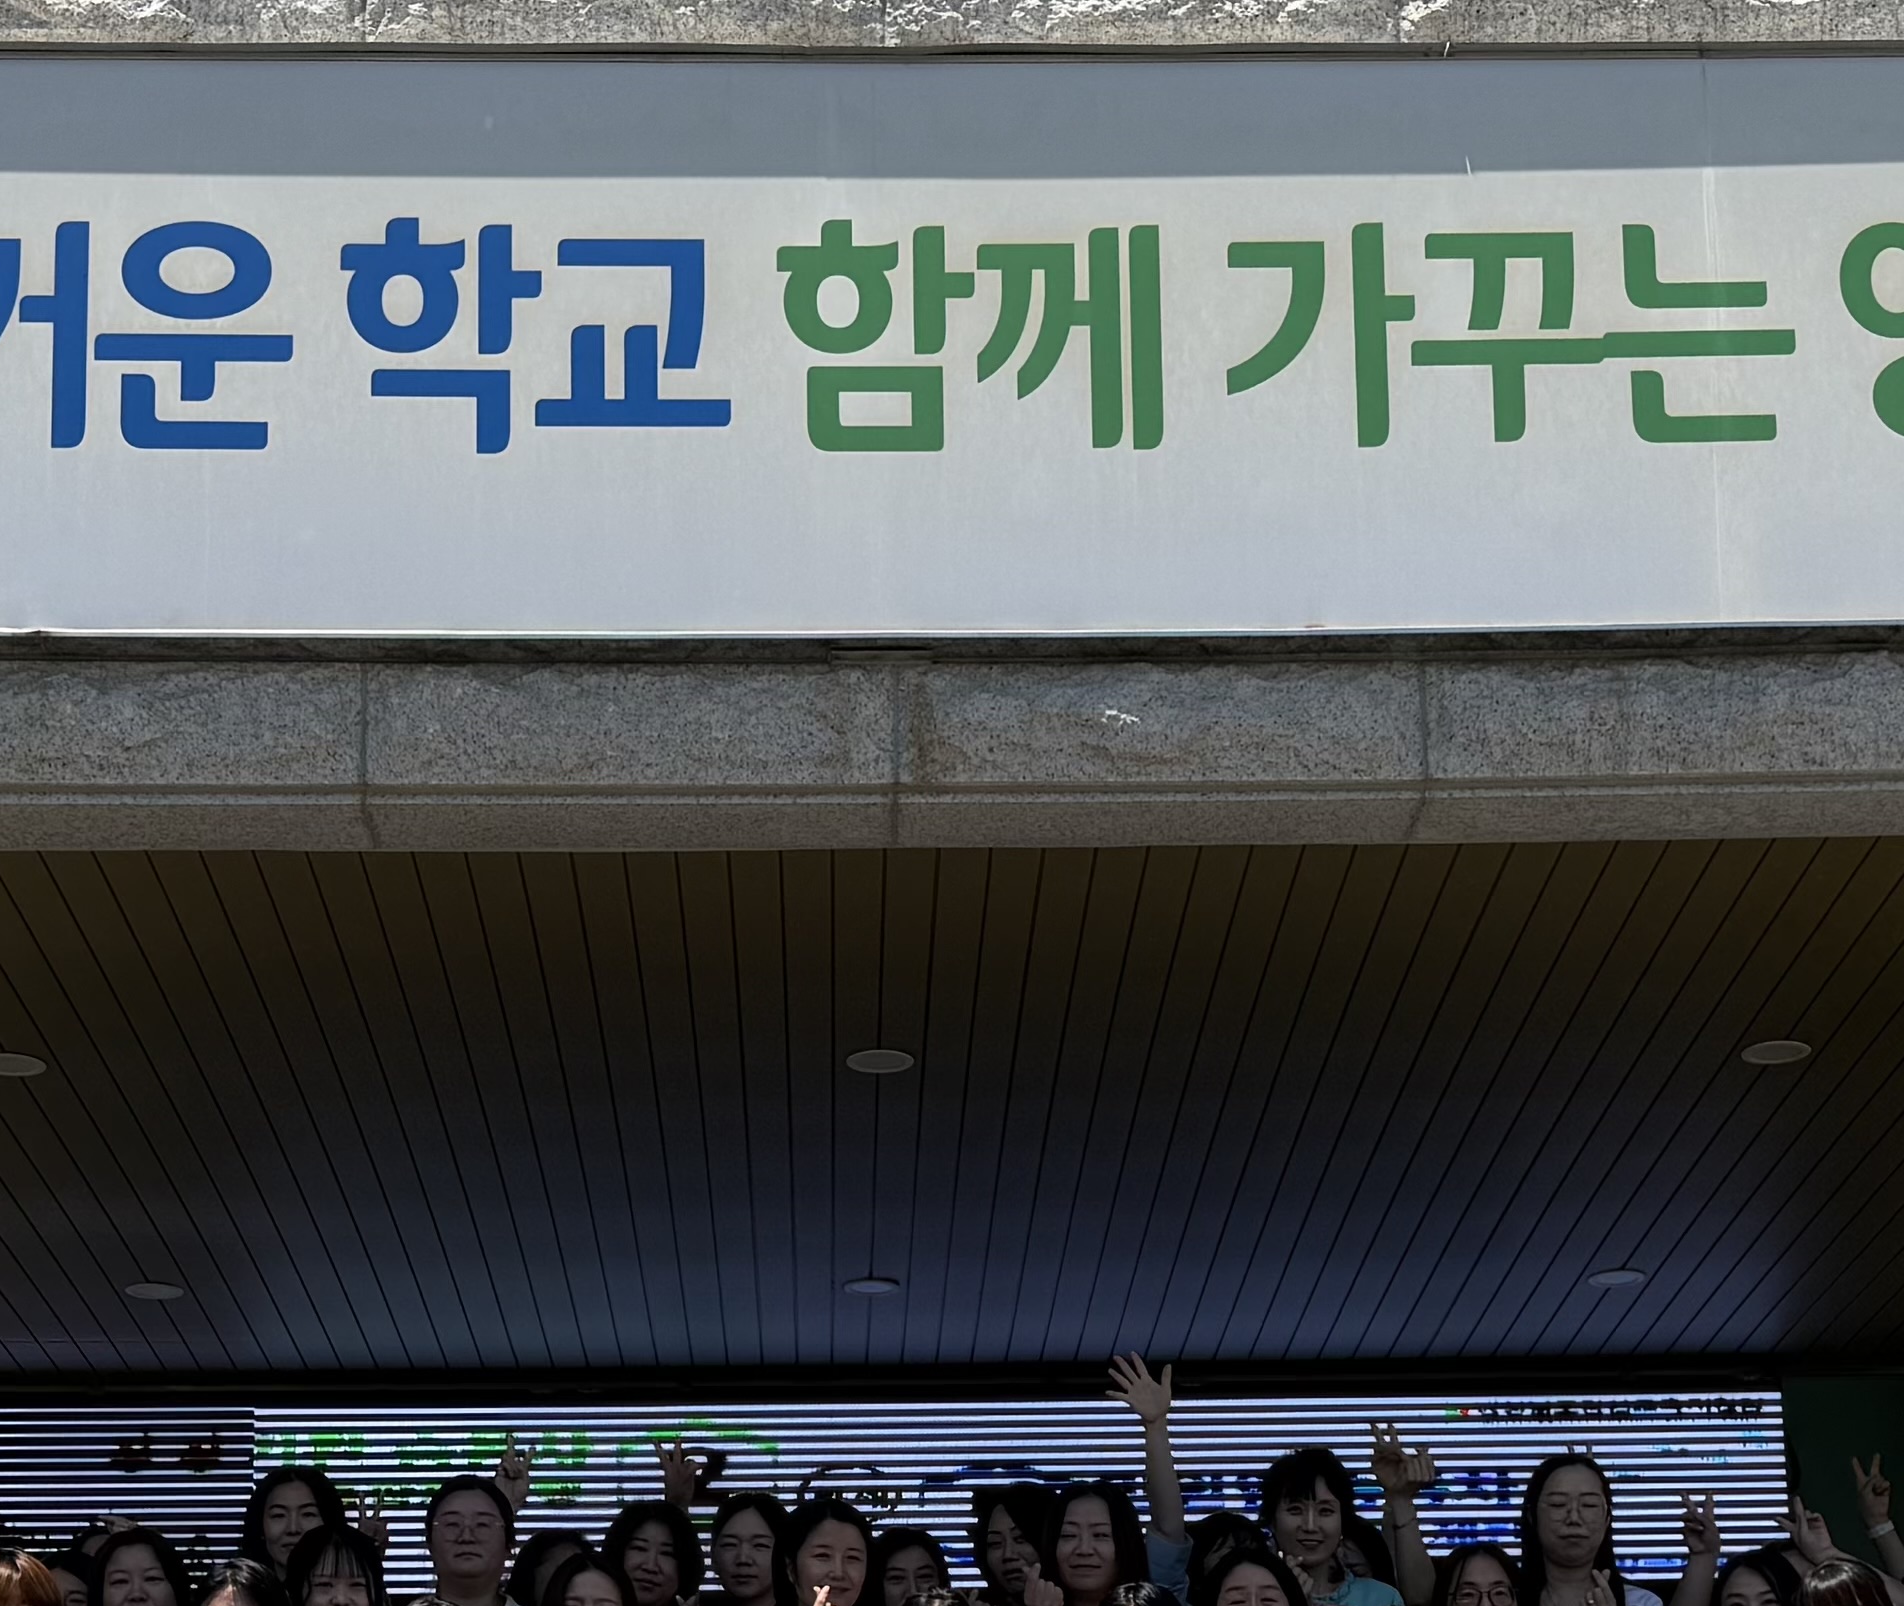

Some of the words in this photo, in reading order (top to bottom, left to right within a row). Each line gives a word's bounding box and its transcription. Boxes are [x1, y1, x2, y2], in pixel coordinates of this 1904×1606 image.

[338, 217, 733, 455] 학교
[776, 218, 1164, 452] 함께
[1225, 222, 1797, 448] 가꾸는
